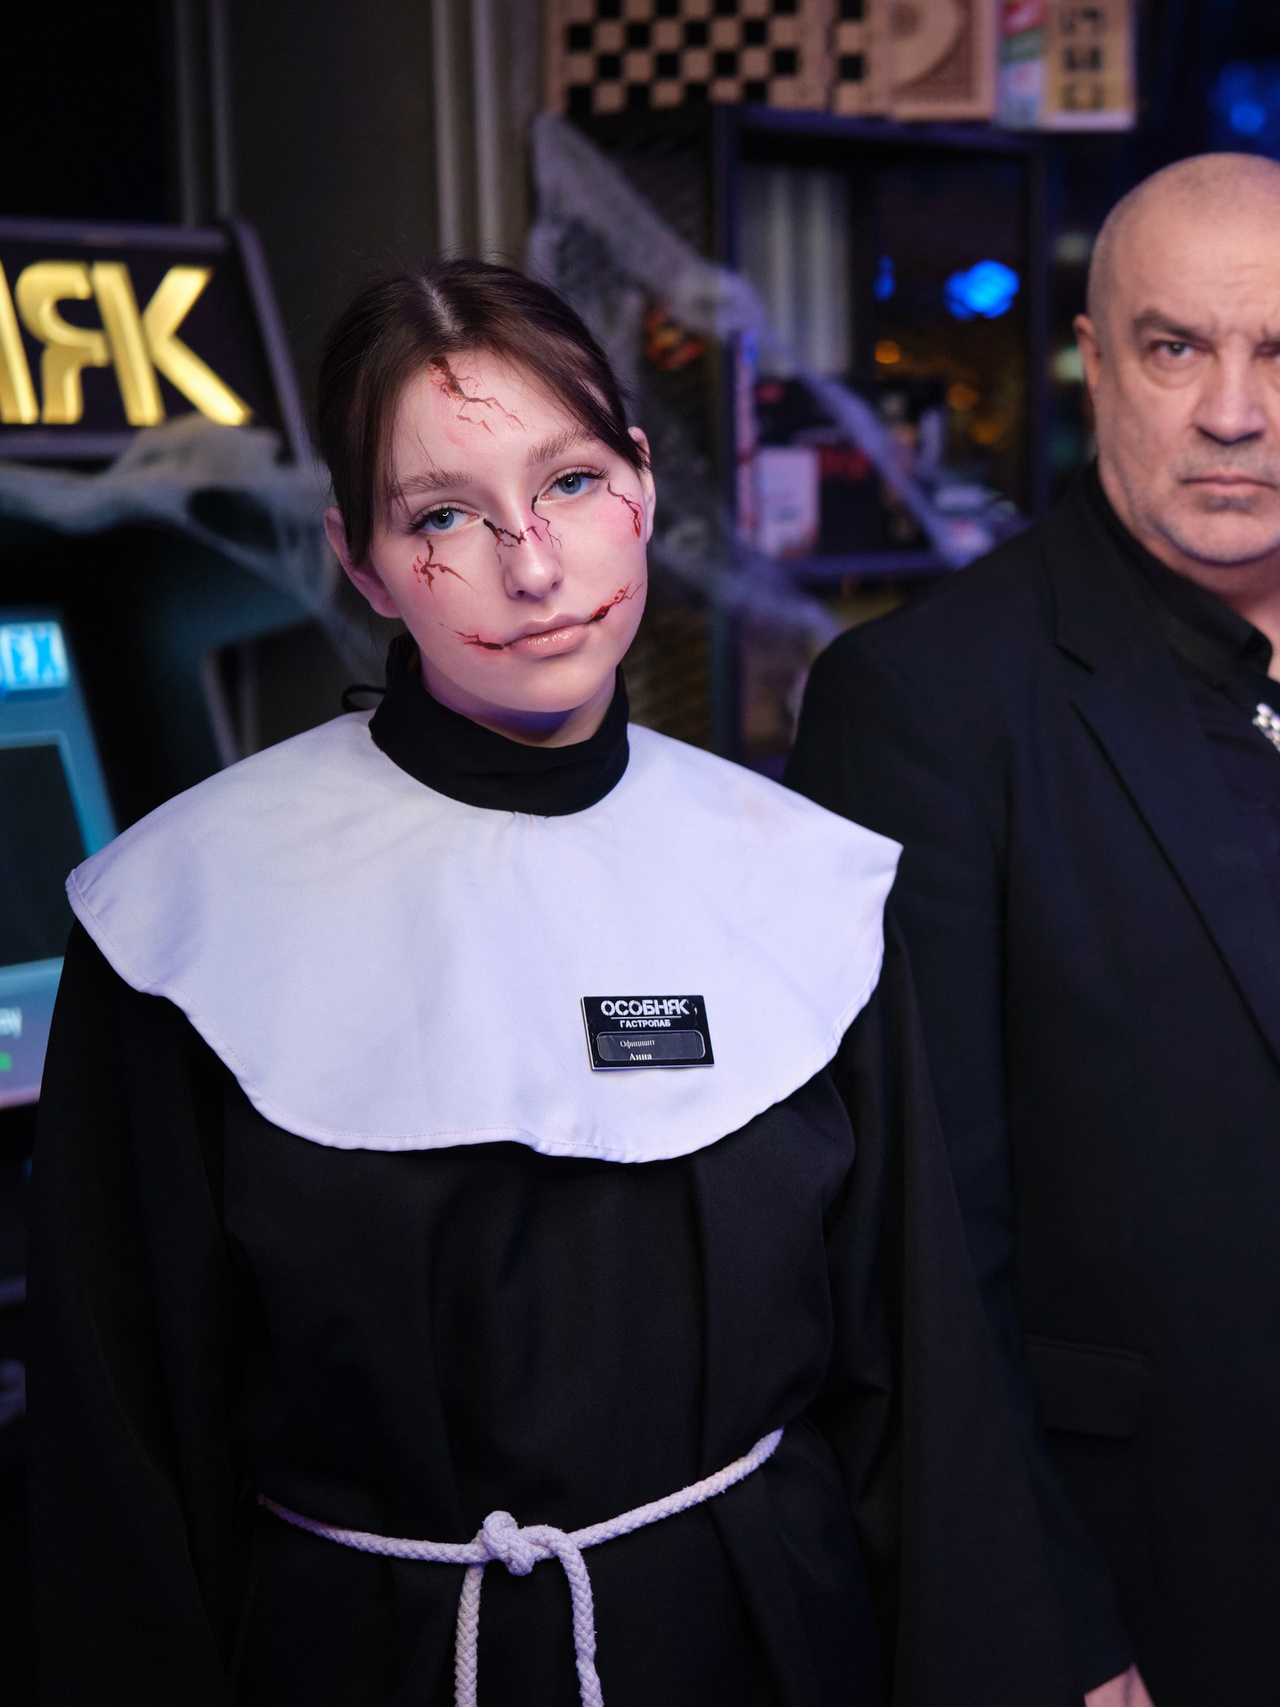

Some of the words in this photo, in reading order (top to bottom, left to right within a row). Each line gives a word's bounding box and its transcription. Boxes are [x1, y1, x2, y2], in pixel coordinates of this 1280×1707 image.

[0, 258, 252, 427] ЯК
[600, 999, 690, 1016] ОСОБНЯК
[619, 1019, 671, 1029] ГАСТРОПАБ
[619, 1039, 656, 1049] Официант
[629, 1052, 653, 1061] Анна
